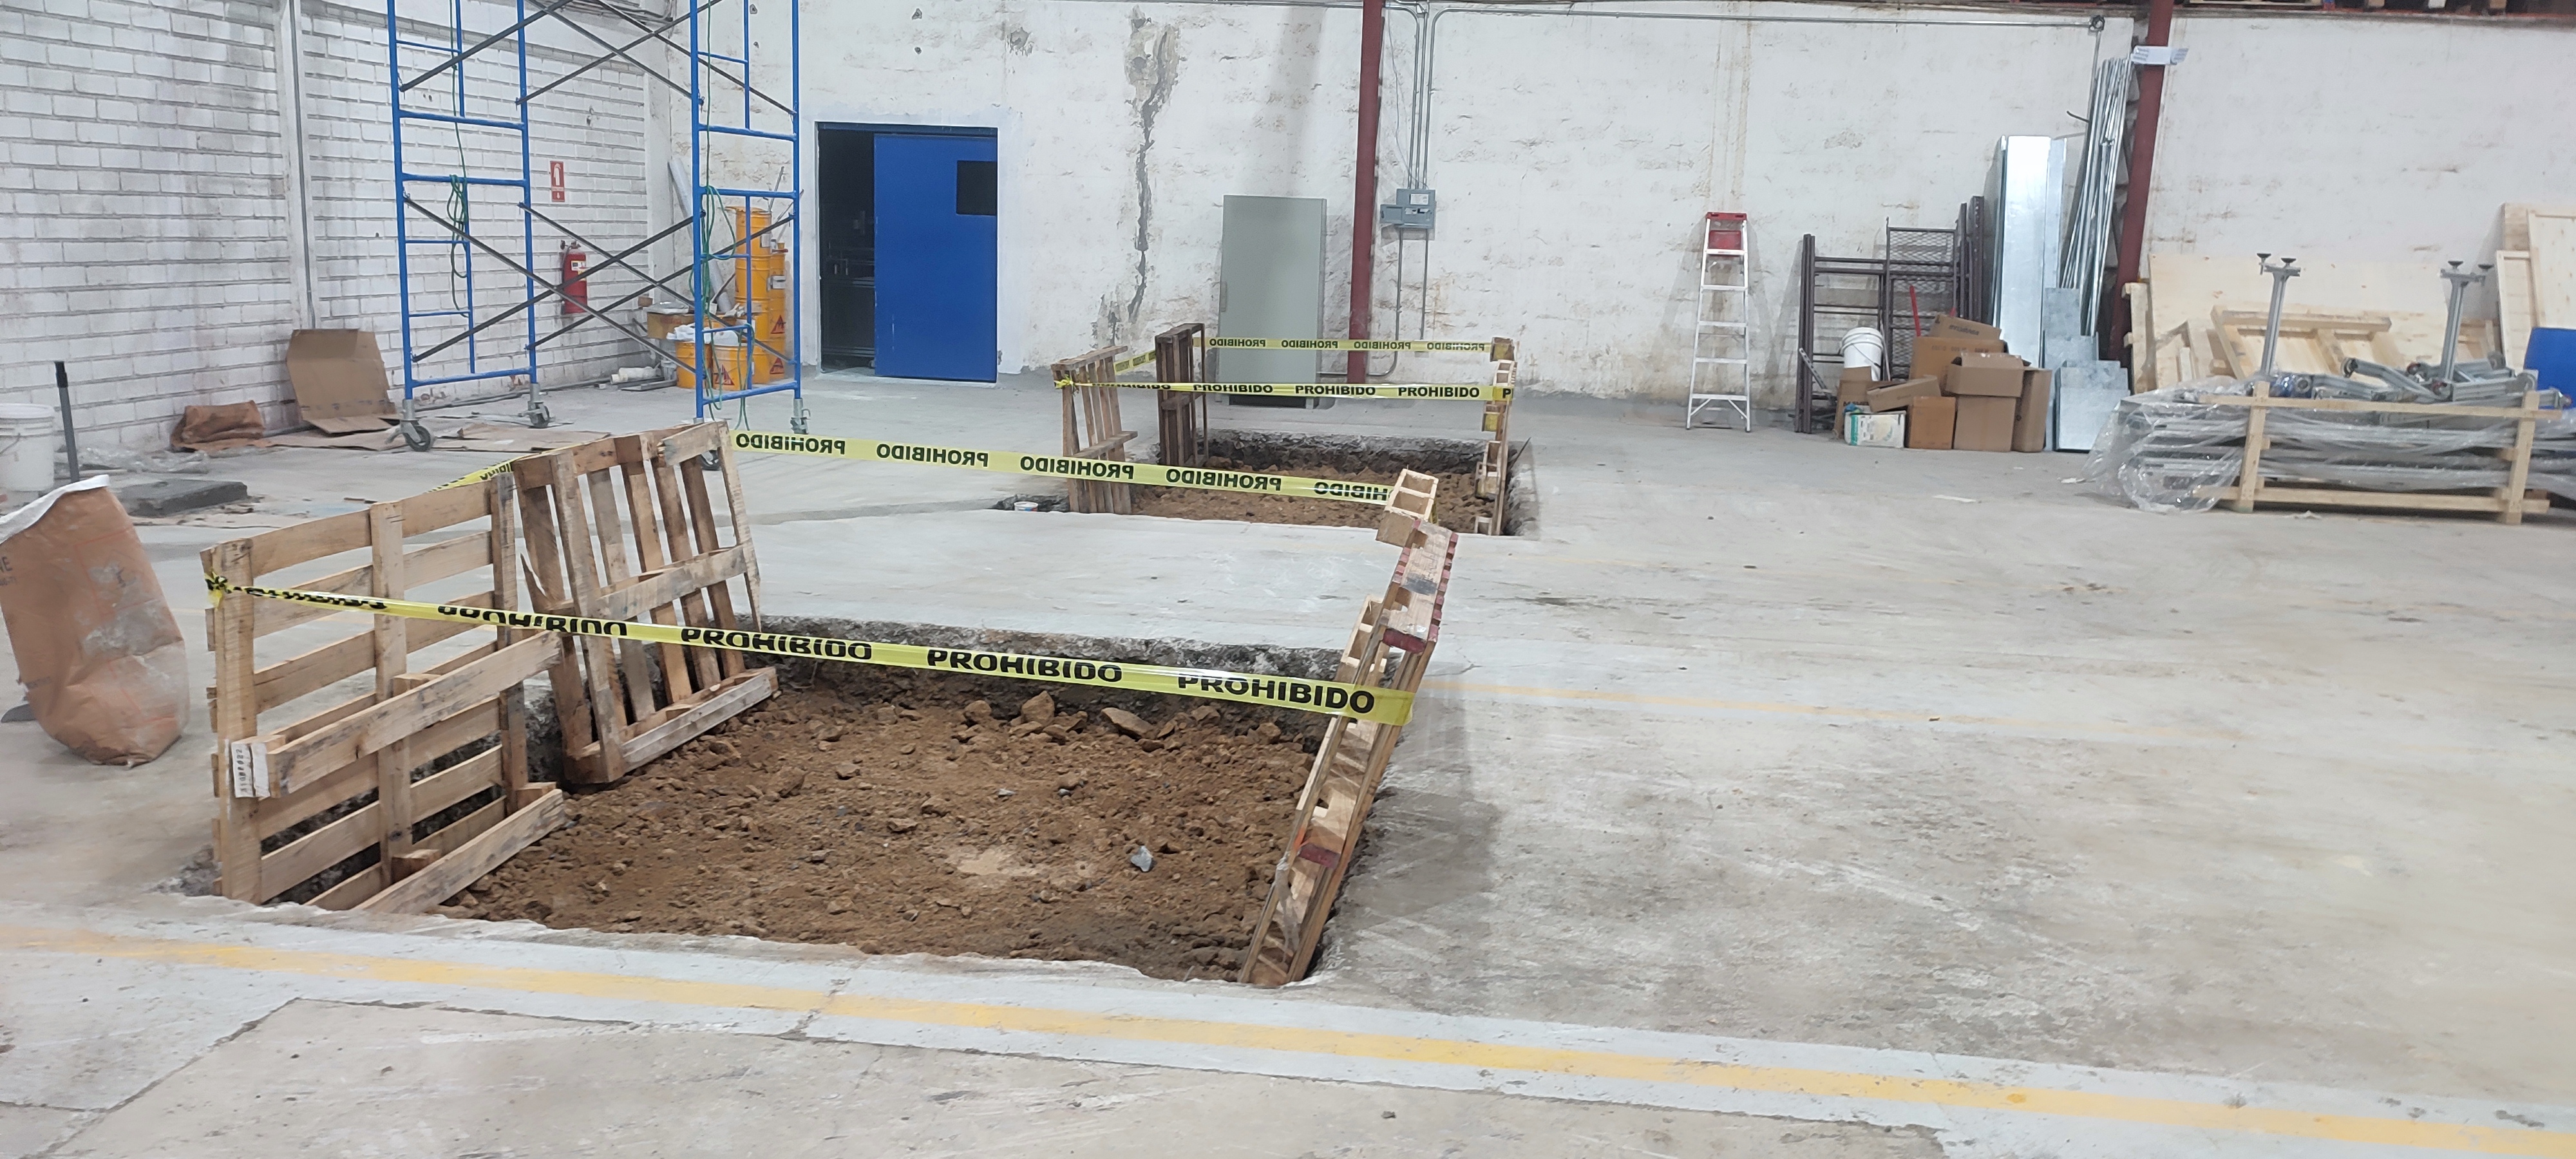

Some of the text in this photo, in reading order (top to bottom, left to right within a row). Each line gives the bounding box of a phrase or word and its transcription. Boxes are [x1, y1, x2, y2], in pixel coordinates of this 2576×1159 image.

[1295, 385, 1376, 395] PROHIBIDO
[1398, 387, 1479, 398] PROHIBIDO
[681, 628, 872, 660] PROHIBIDO
[927, 649, 1122, 683] PROHIBIDO
[1178, 674, 1375, 713] PROHIBIDO
